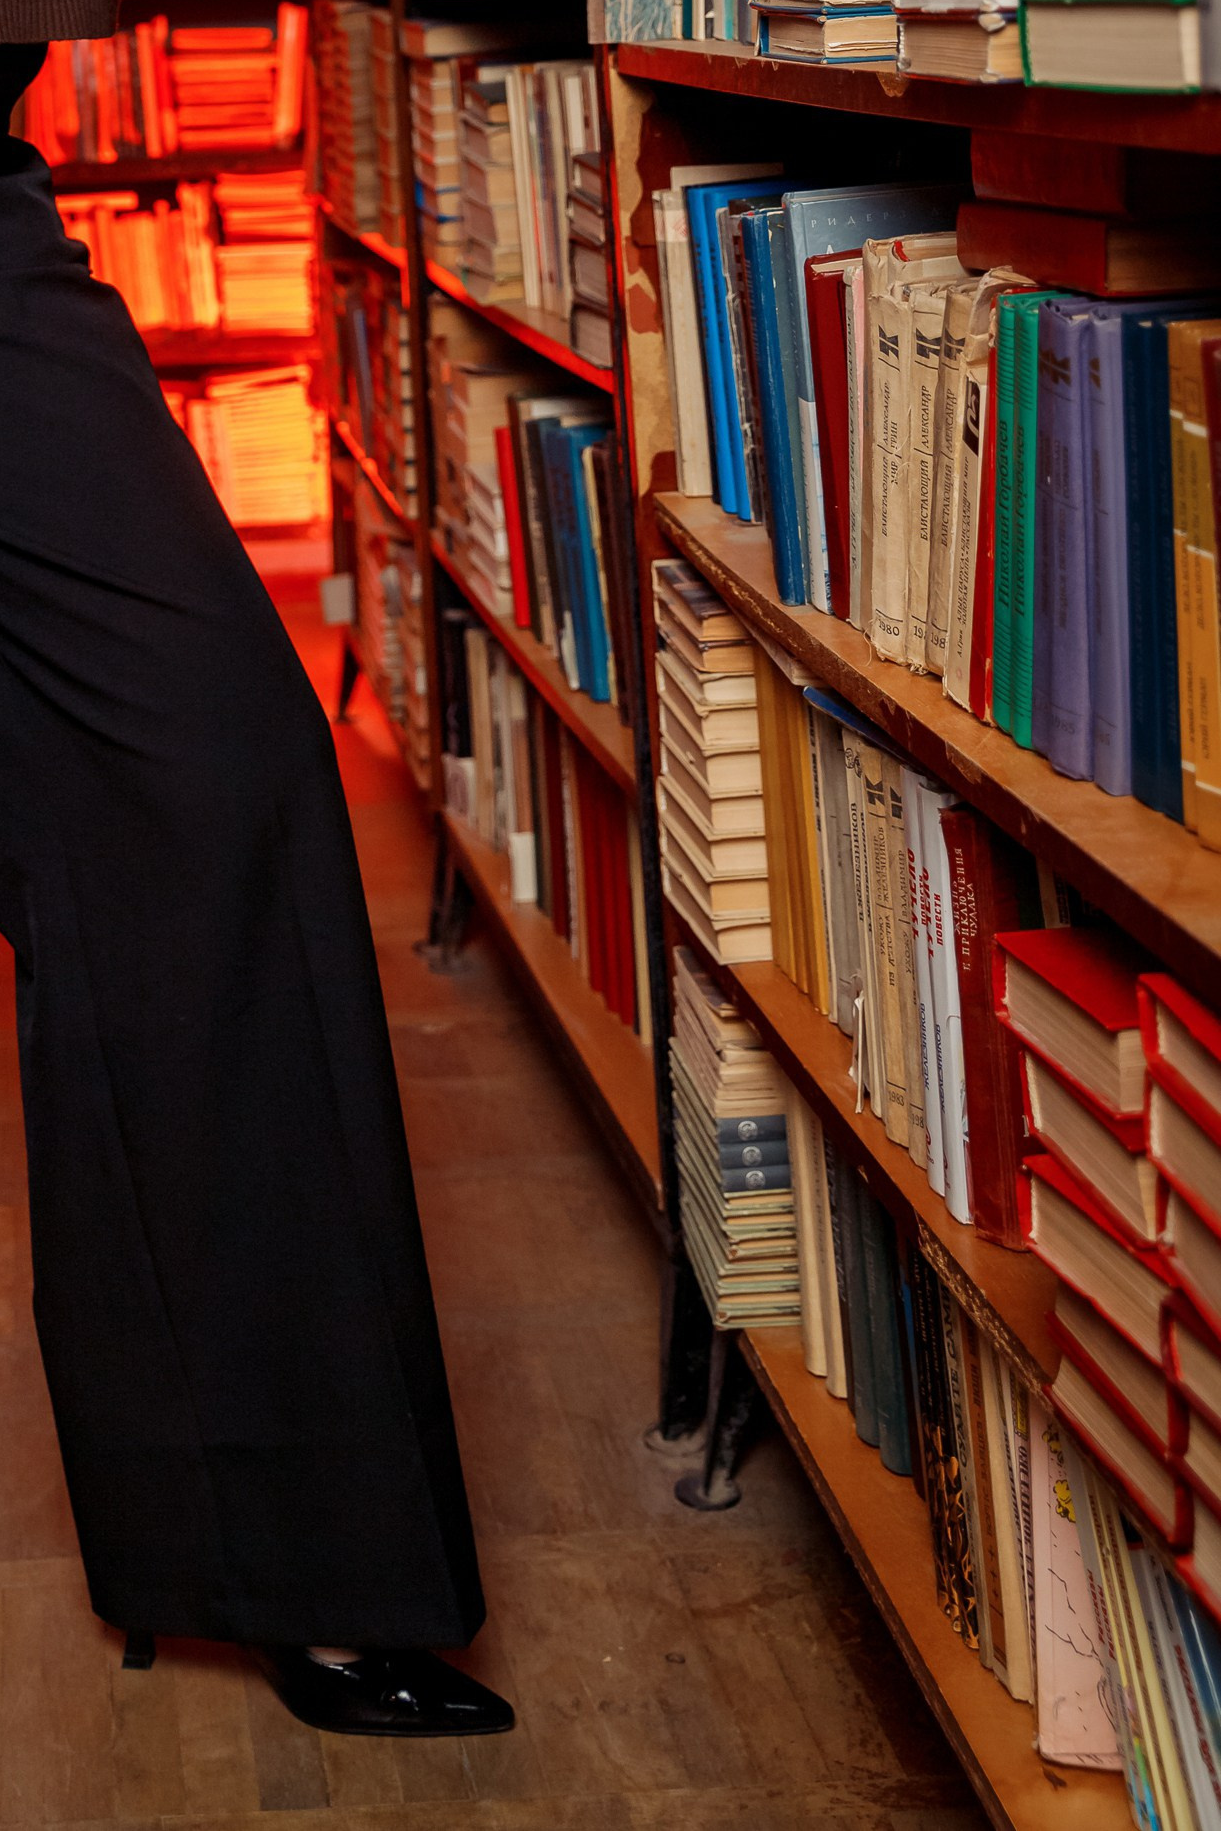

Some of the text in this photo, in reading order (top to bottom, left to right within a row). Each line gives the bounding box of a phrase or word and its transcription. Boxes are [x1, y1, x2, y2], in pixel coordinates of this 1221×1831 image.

[880, 380, 891, 537] БЛИСТАЮЩИЙ АЛЕКСАНДР
[919, 385, 932, 541] БЛИСТАЮЩИЙ АЛЕКСАНДР
[940, 388, 957, 547] БЛИСТАЮЩИЙ АЛЕКСАНДР
[998, 420, 1011, 608] Николай Горбачев
[1014, 425, 1027, 617] Николай Горбачев
[878, 618, 900, 636] 1980
[878, 826, 889, 903] ЖЕЛЕЗНИКОВ
[898, 850, 912, 974] УХОЖУ ВЛАДИМИР
[954, 847, 970, 956] ПРИКЛЮЧЕНИЯ
[967, 882, 977, 936] ЧУДАКА
[885, 914, 895, 967] ДЕТСТВА
[919, 1002, 930, 1090] ЖЕЛЕЗНИКОВ
[935, 1023, 945, 1114] ЖЕЛЕЗНИКОВ
